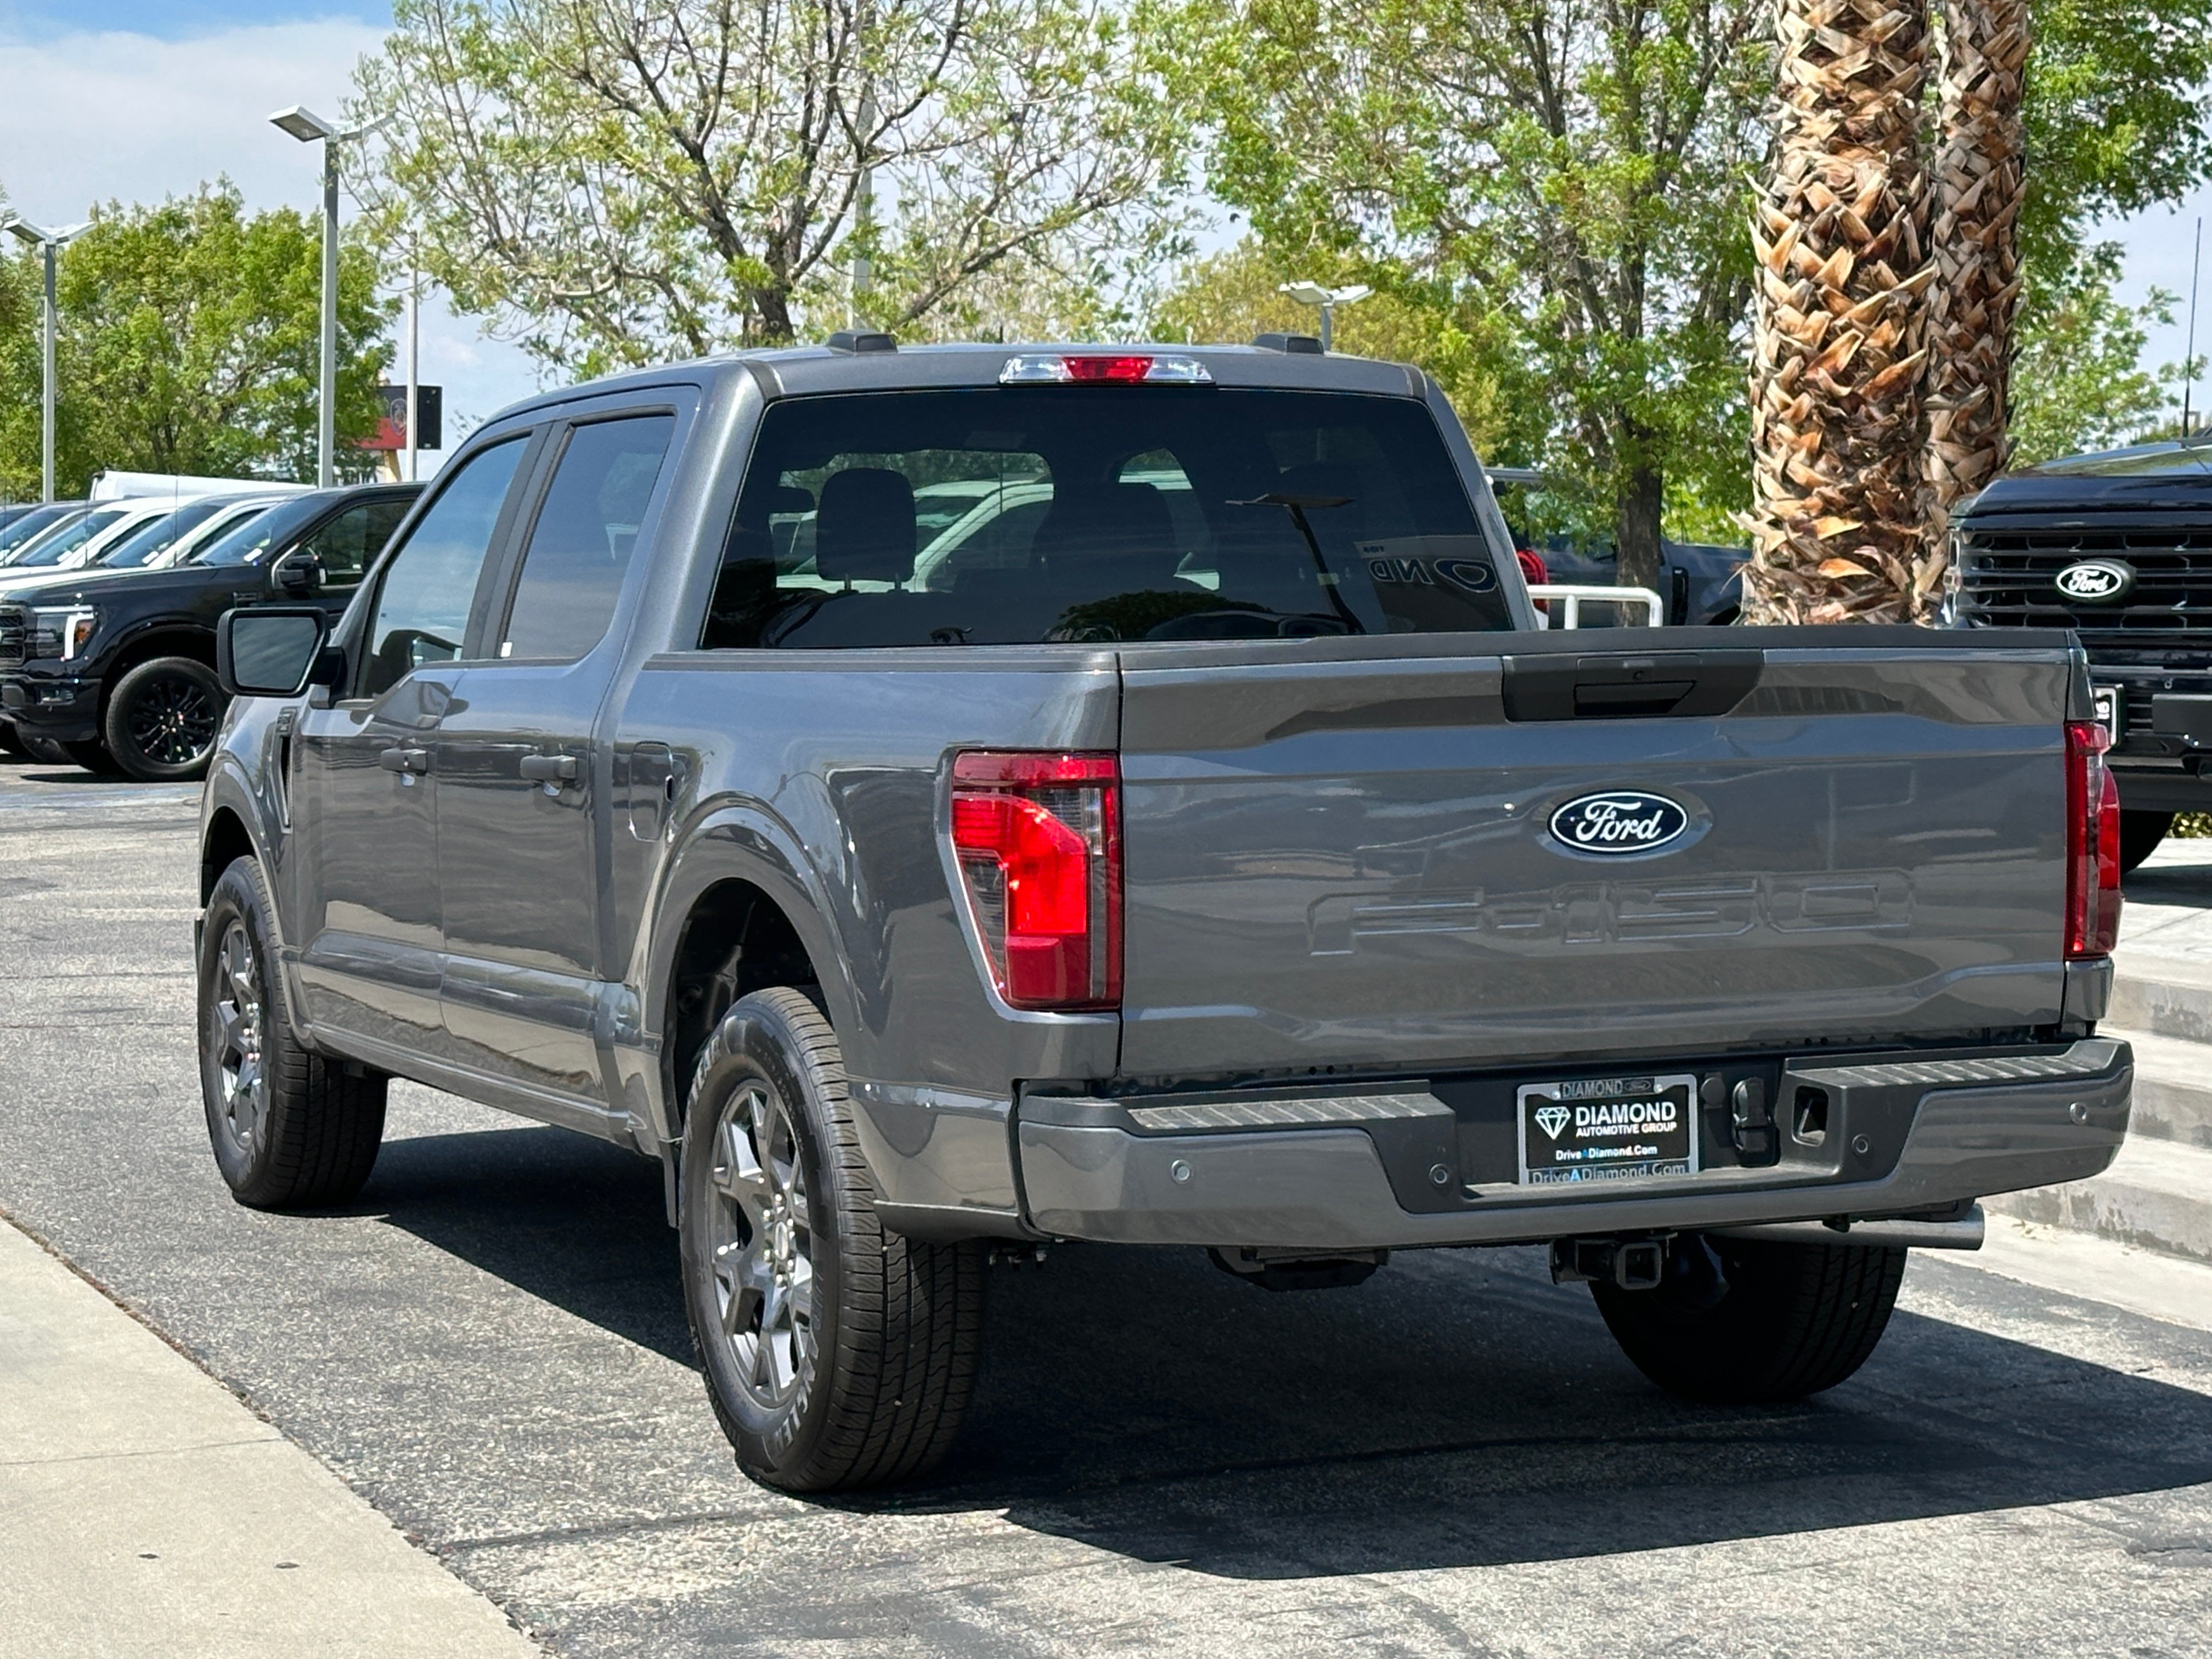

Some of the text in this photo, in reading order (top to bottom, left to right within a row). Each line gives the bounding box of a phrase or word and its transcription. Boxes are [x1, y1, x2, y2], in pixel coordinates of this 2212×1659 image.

[2069, 570, 2109, 591] Ford
[1577, 799, 1662, 841] Ford
[1308, 868, 1915, 956] F-150
[1563, 1081, 1623, 1097] DIAMOND
[1576, 1102, 1676, 1126] DIAMOND
[1576, 1122, 1677, 1137] AUTOMOTIVE GROUP
